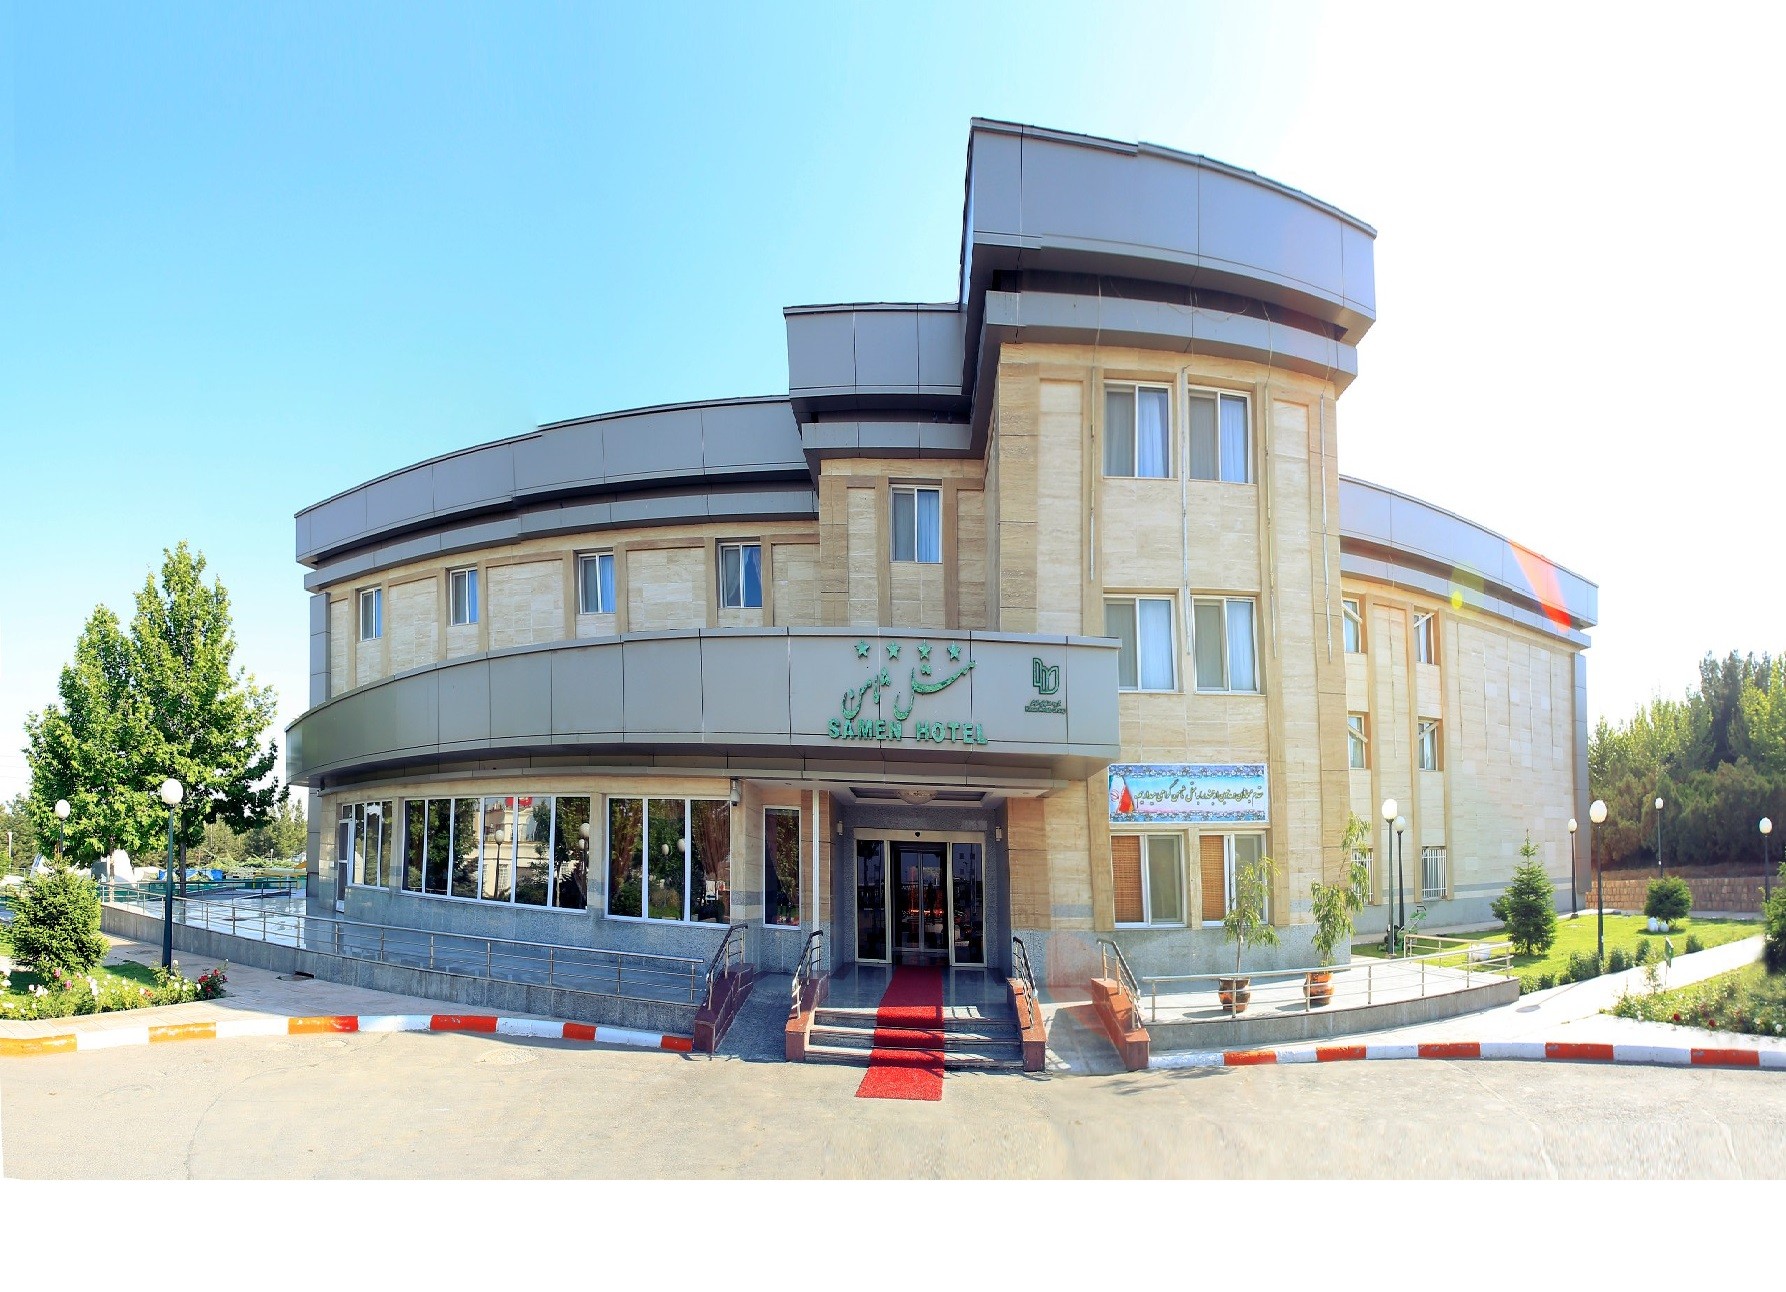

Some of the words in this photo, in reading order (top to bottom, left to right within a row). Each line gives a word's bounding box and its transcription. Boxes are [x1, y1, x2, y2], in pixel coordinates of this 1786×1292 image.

[841, 666, 891, 720] ثامن
[893, 659, 977, 721] هتل
[827, 717, 903, 742] SAMEN
[915, 720, 988, 745] HOTEL
